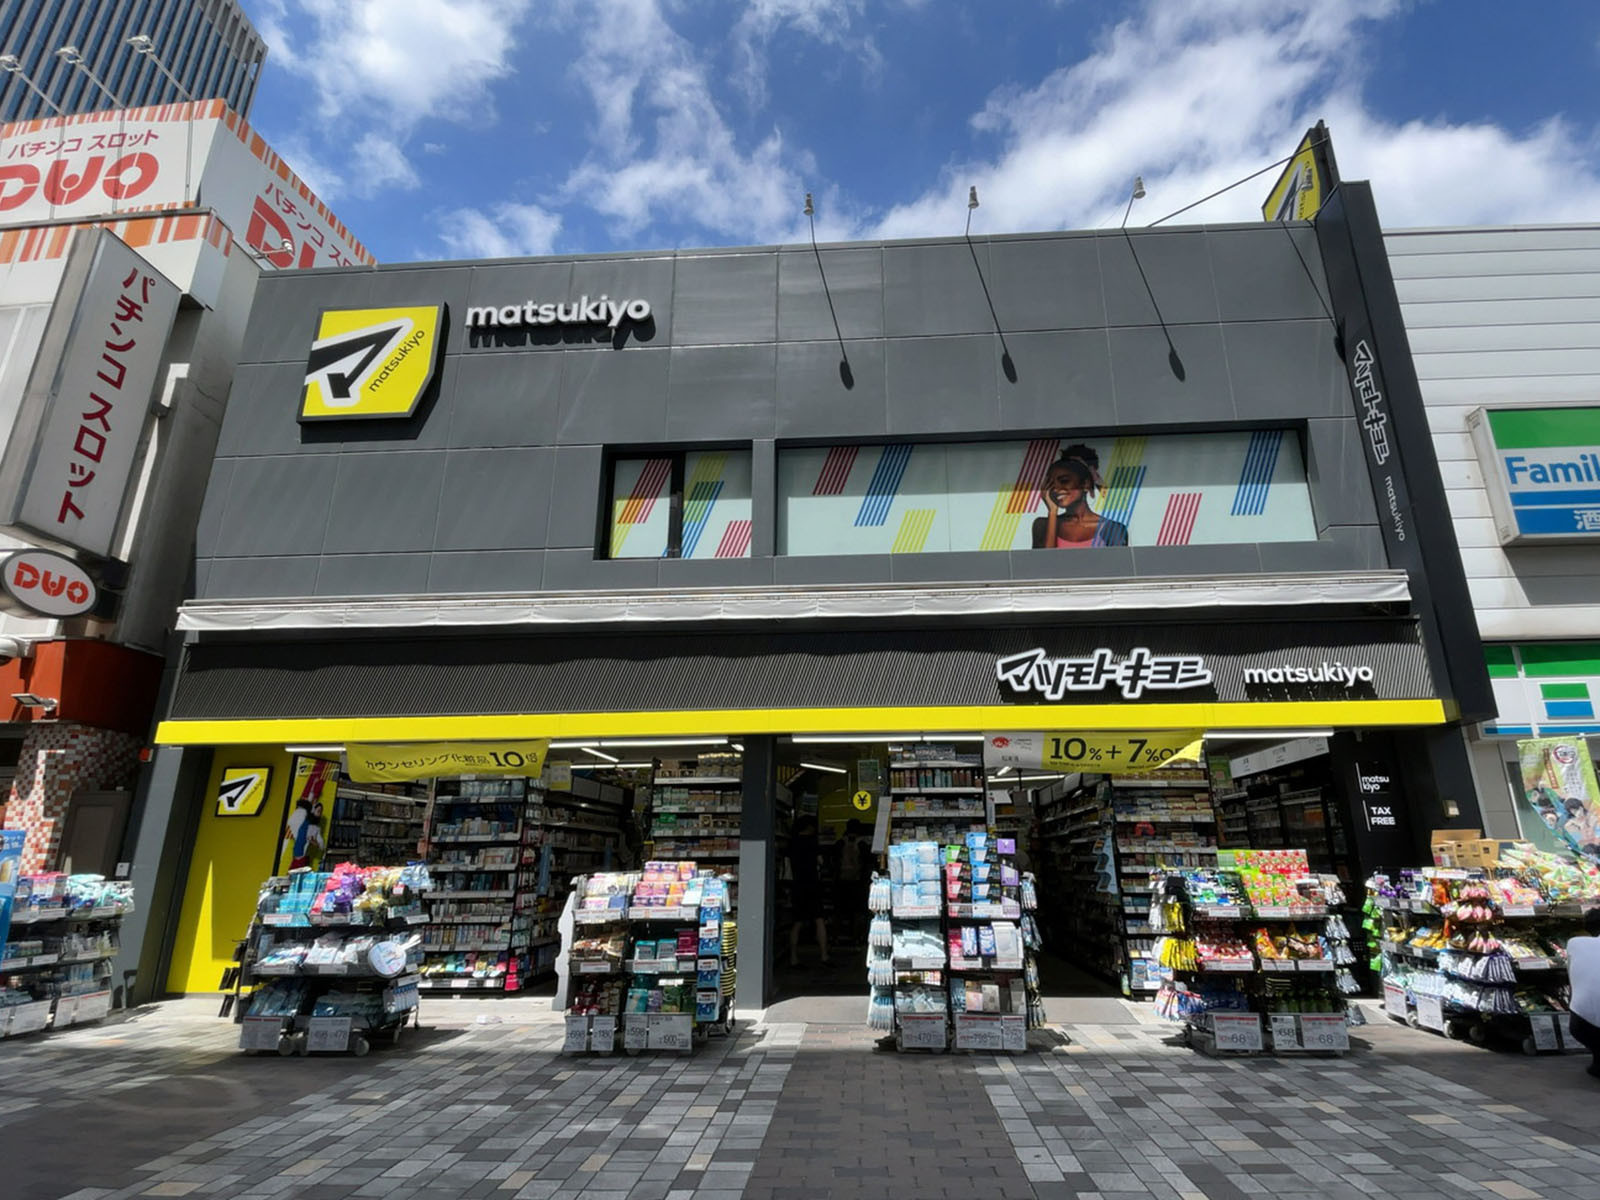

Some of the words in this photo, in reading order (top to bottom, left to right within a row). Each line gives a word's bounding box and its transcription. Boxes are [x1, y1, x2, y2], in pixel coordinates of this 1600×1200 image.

[88, 129, 159, 151] スロット
[0, 152, 159, 211] DUO
[97, 267, 156, 390] パチンコ
[464, 295, 652, 328] matsukiyo
[368, 329, 426, 393] matsukiyo
[1354, 339, 1390, 466] マツモトキヨシ
[57, 392, 114, 524] スロット
[1385, 475, 1406, 542] matsukiyo
[13, 561, 90, 605] DUO
[996, 647, 1212, 700] マツモトキヨシ
[1243, 661, 1374, 688] matsukiyo
[1361, 775, 1390, 783] matsu
[1370, 806, 1392, 815] TAX
[1371, 816, 1396, 825] FREE
